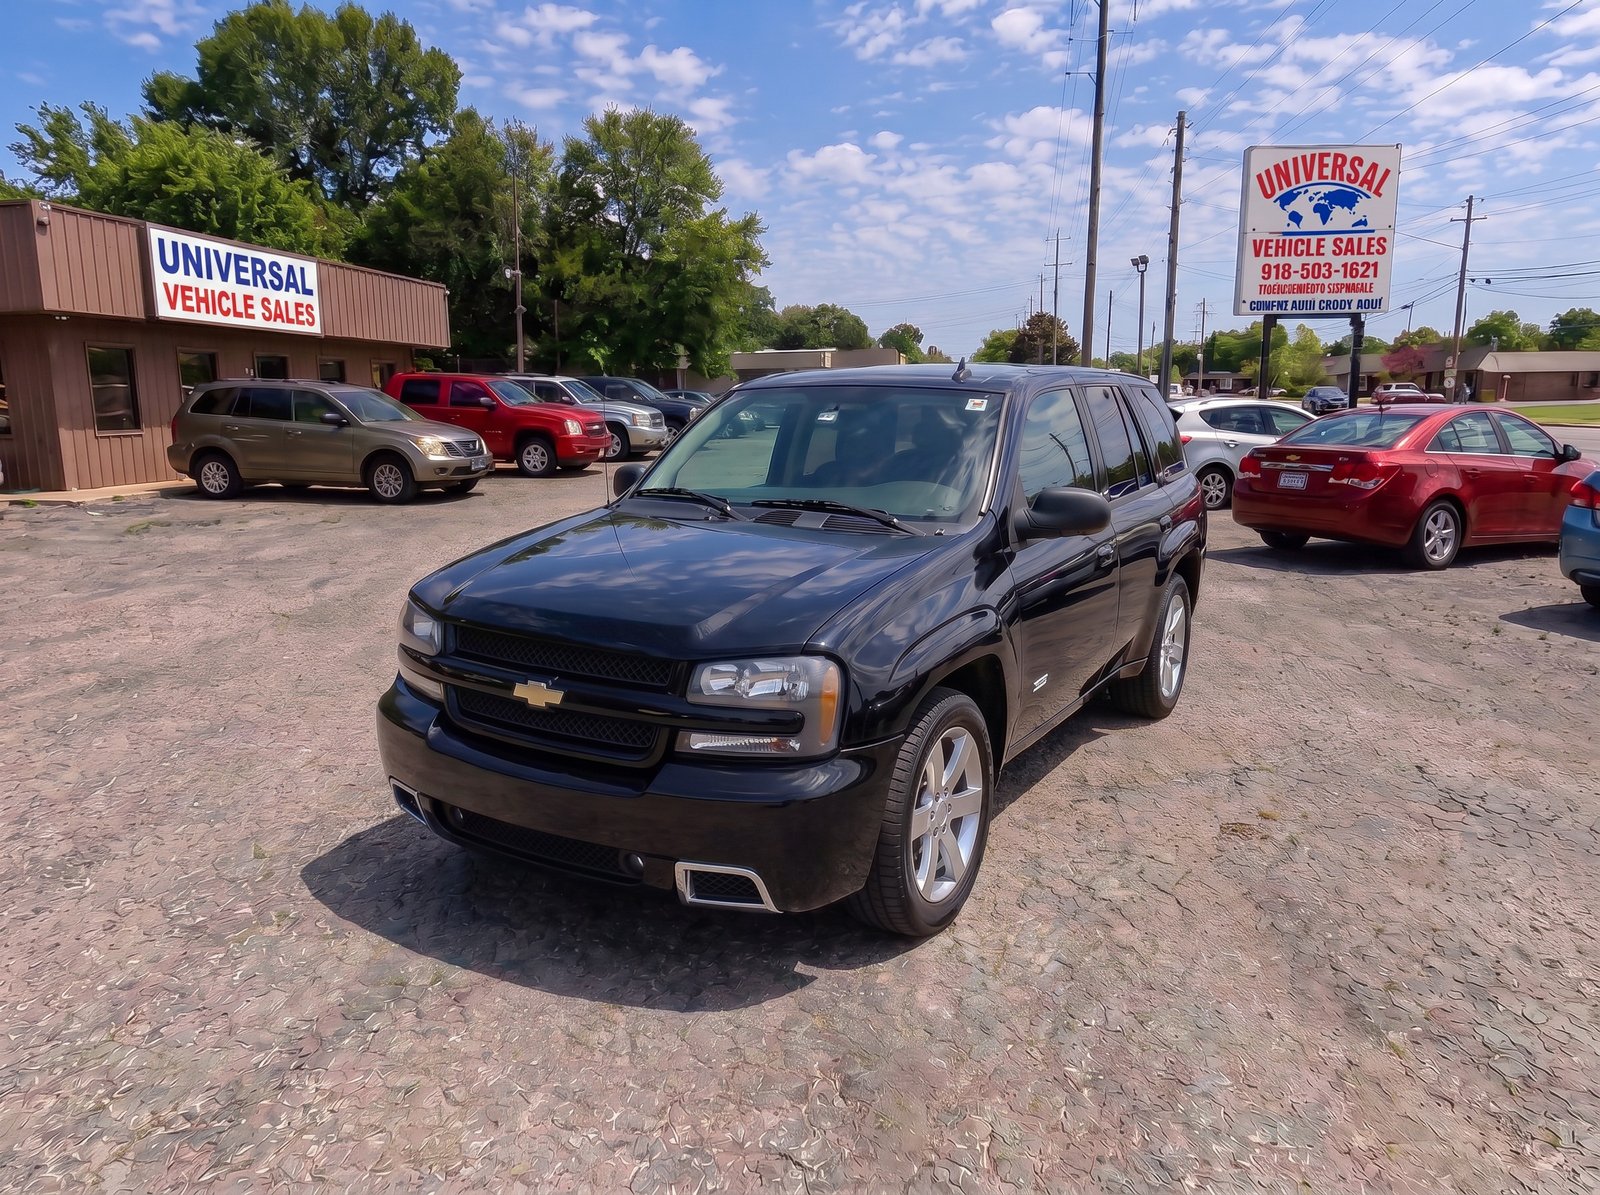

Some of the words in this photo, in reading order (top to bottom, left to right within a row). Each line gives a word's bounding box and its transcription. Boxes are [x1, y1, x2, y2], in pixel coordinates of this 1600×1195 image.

[1256, 152, 1391, 199] UNIVERSAL
[158, 238, 314, 296] UNIVERSAL
[1252, 238, 1326, 257] VEHICLE
[1332, 237, 1387, 256] SALES
[1261, 261, 1379, 280] 918-503-1621
[163, 282, 255, 319] VEHICLE
[261, 297, 316, 327] SALES
